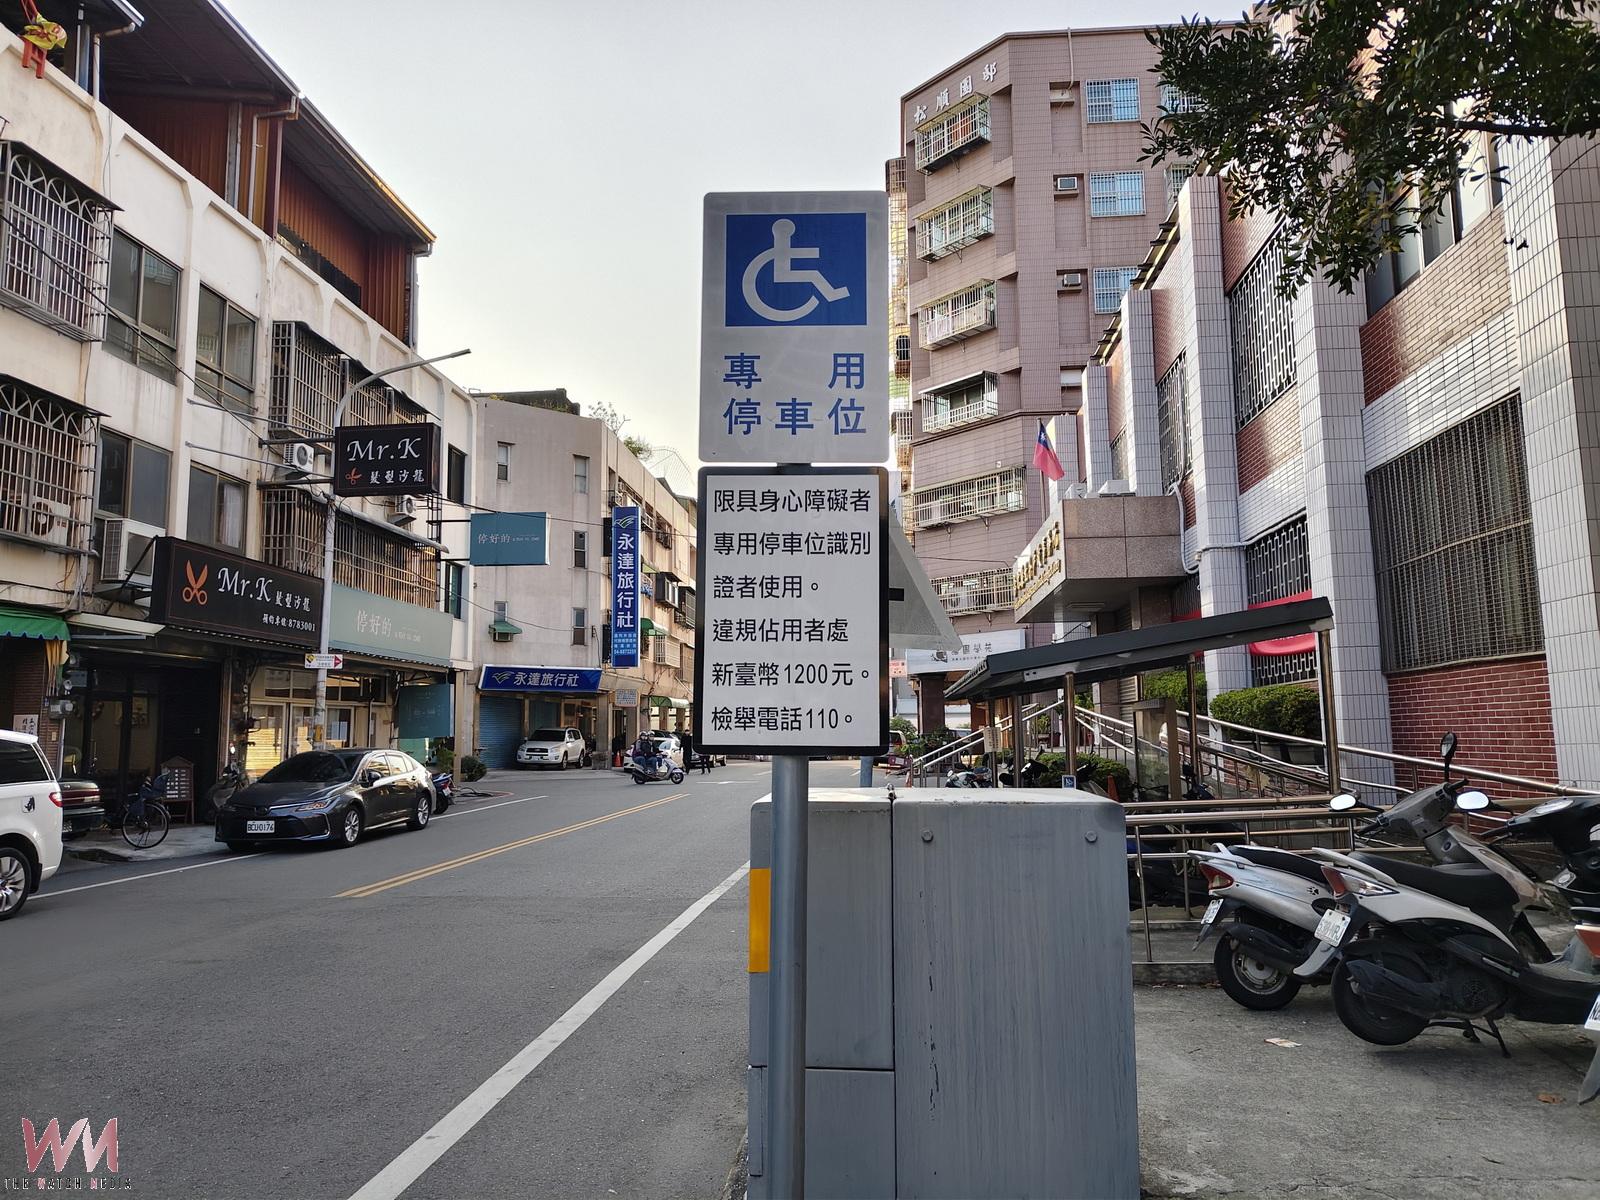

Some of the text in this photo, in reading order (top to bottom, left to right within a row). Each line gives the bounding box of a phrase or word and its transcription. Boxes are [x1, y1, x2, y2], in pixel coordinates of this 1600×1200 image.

[723, 397, 867, 436] 停車位
[346, 437, 422, 462] Mr.K
[713, 488, 872, 514] 限具身心障礙者
[713, 531, 872, 556] 專用停車位識別
[217, 567, 273, 602] Mr.K
[616, 532, 635, 629] 永達旅行社
[712, 574, 820, 600] 證者使用。
[712, 617, 850, 643] 違規佔用者處
[514, 670, 580, 687] 永達旅行社
[711, 661, 870, 687] 新臺幣1200元。
[711, 705, 853, 732] 檢舉電話110。
